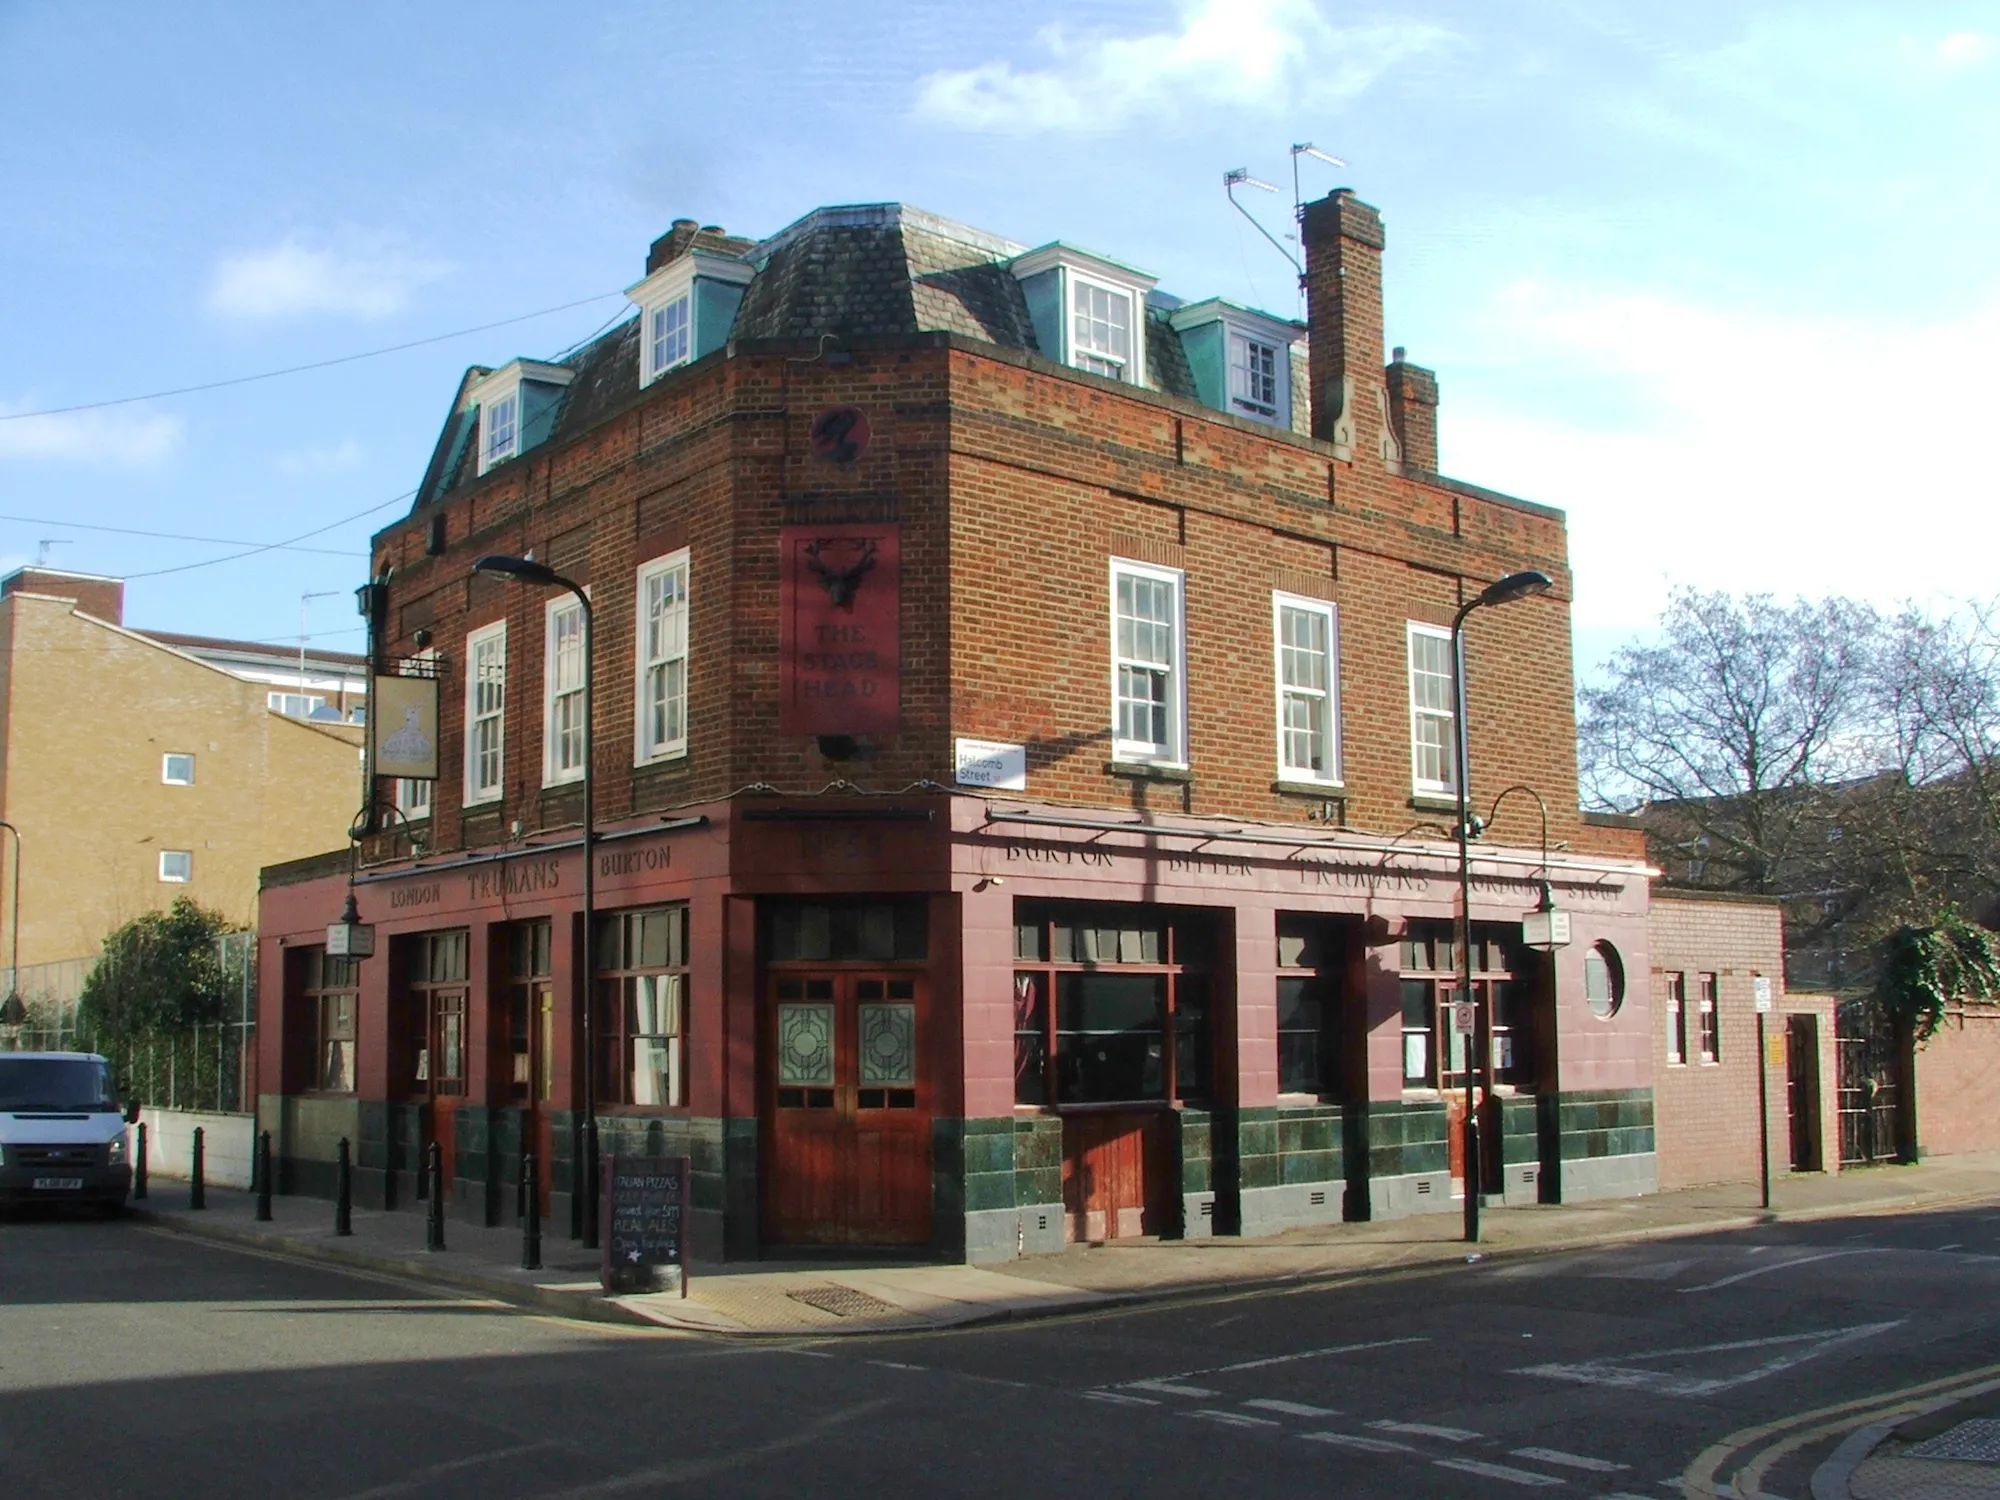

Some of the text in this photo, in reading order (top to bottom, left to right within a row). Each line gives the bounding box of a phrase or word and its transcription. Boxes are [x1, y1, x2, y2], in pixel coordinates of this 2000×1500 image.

[815, 624, 866, 643] THE
[804, 679, 878, 698] HEAD
[959, 754, 1003, 770] Halcomb
[959, 768, 990, 782] Street
[391, 845, 671, 908] LONDON TRUMANS BURTON
[614, 1219, 678, 1234] REAL ALES
